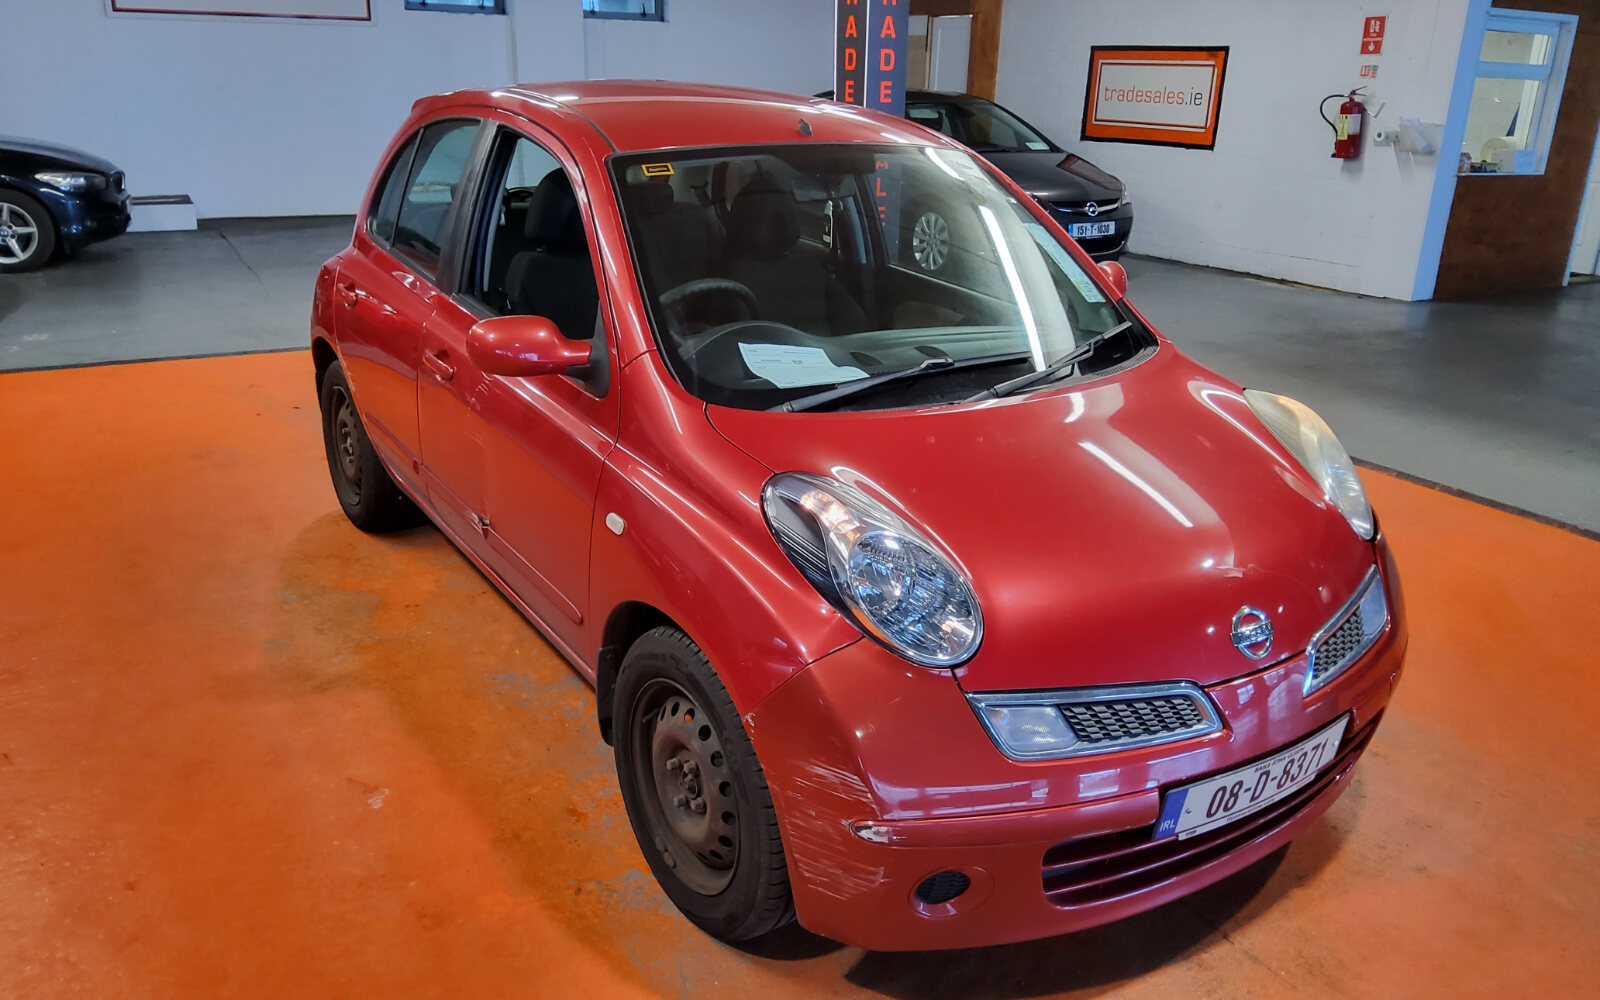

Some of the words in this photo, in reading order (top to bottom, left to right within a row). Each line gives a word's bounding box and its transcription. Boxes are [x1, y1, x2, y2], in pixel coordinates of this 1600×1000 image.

[845, 0, 857, 103] ADE
[880, 0, 896, 103] ADE
[1104, 84, 1203, 106] tradesales.ie
[1206, 737, 1330, 819] 08-D-8371
[1160, 819, 1176, 832] IRL
